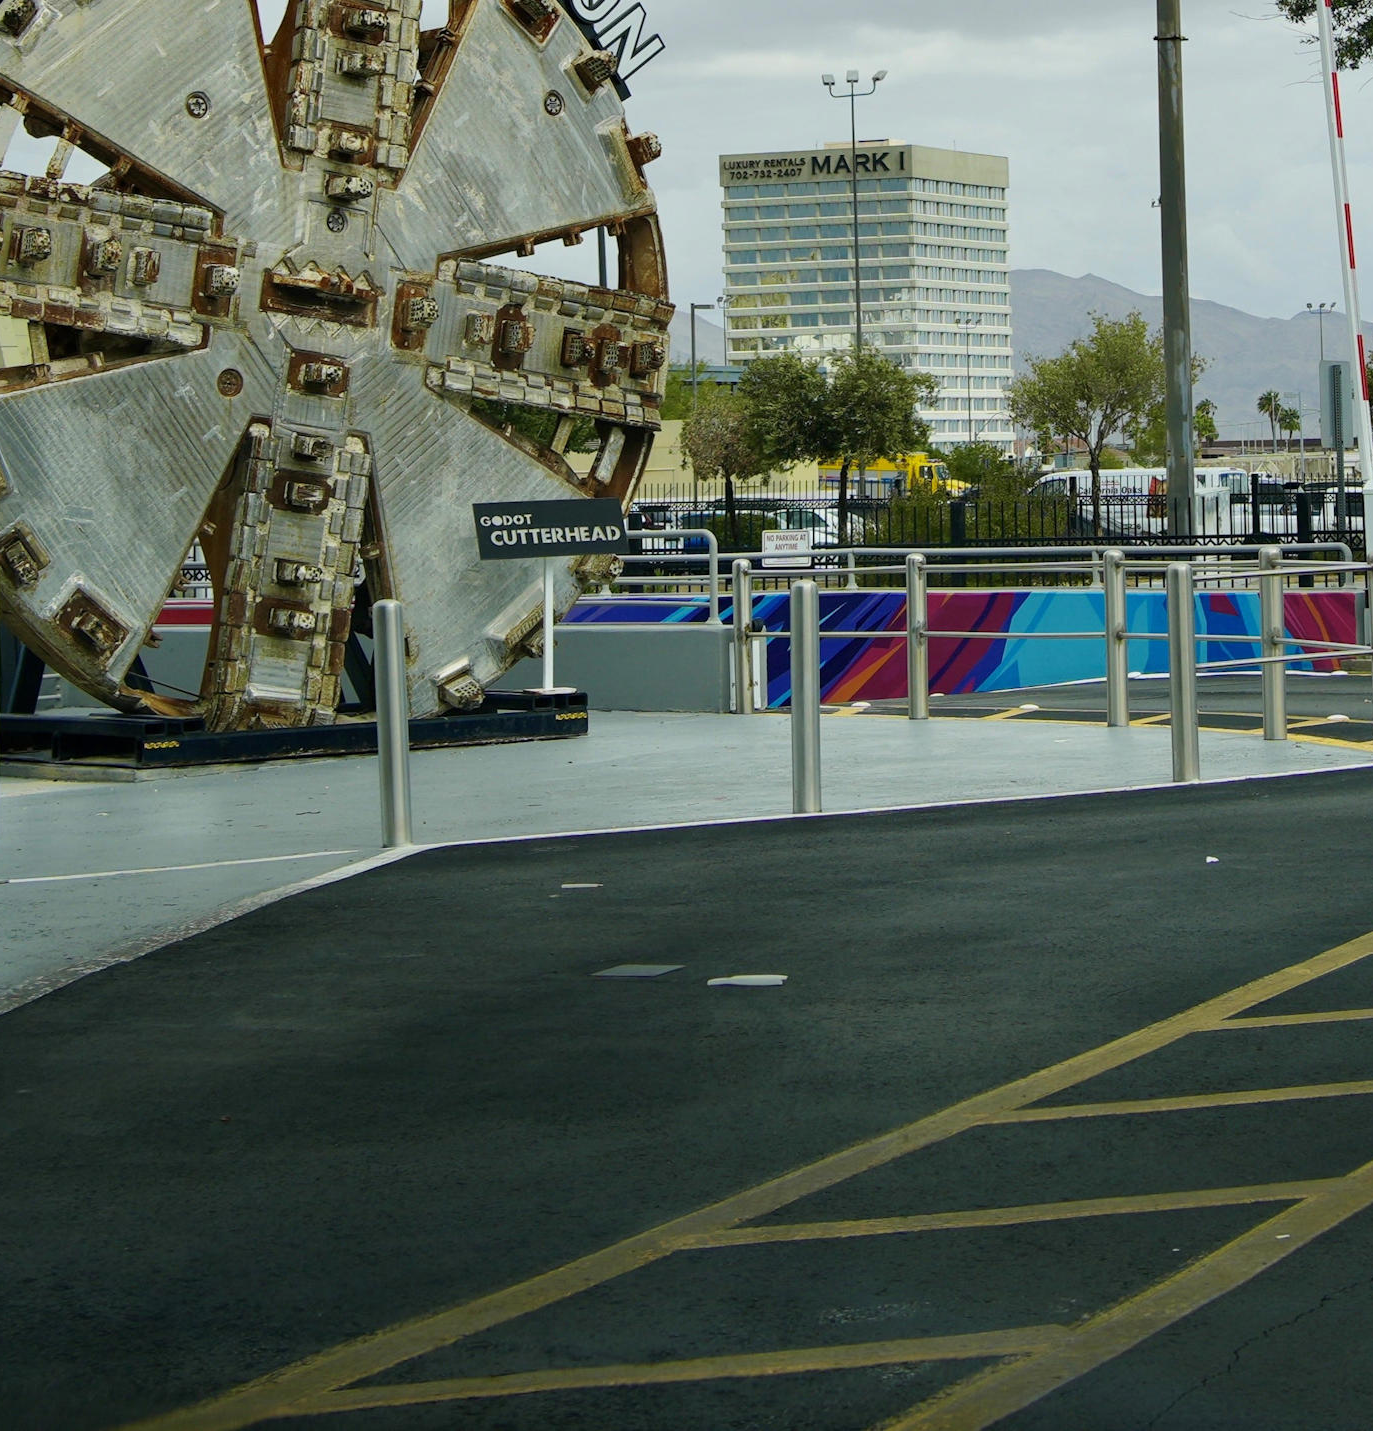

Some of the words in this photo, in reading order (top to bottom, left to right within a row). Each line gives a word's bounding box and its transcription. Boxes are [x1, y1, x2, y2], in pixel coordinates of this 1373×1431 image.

[723, 160, 761, 170] LUXURY
[764, 158, 806, 168] RENTALS
[811, 152, 890, 176] MARK
[898, 151, 906, 171] I
[729, 168, 802, 180] 702-732-2407
[1079, 486, 1118, 495] Calrnia
[1121, 486, 1142, 494] Oaks
[480, 513, 532, 527] GODOT
[490, 525, 621, 546] CUTTERHEAD
[775, 543, 798, 551] ANYTIME
